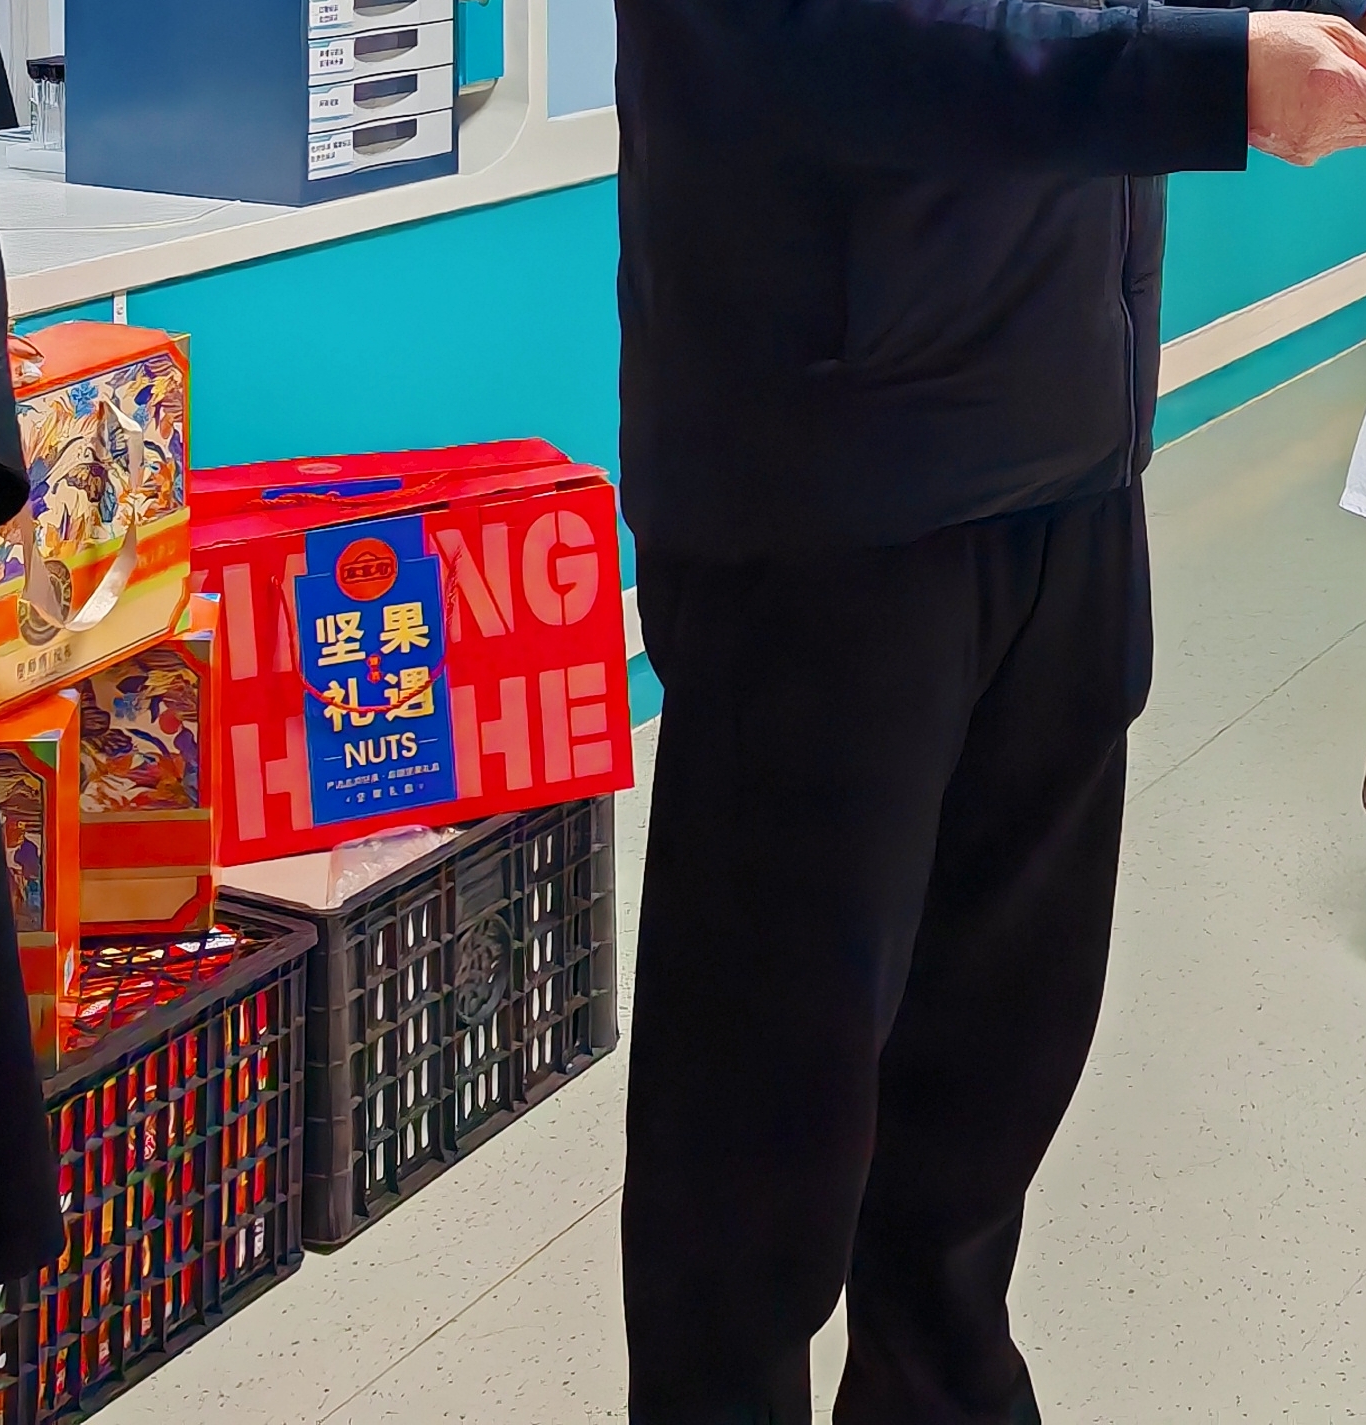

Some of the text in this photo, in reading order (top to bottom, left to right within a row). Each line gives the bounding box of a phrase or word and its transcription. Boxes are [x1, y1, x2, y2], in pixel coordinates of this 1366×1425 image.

[316, 602, 430, 667] 坚果
[320, 666, 436, 732] 礼遇
[344, 732, 418, 769] NUTS
